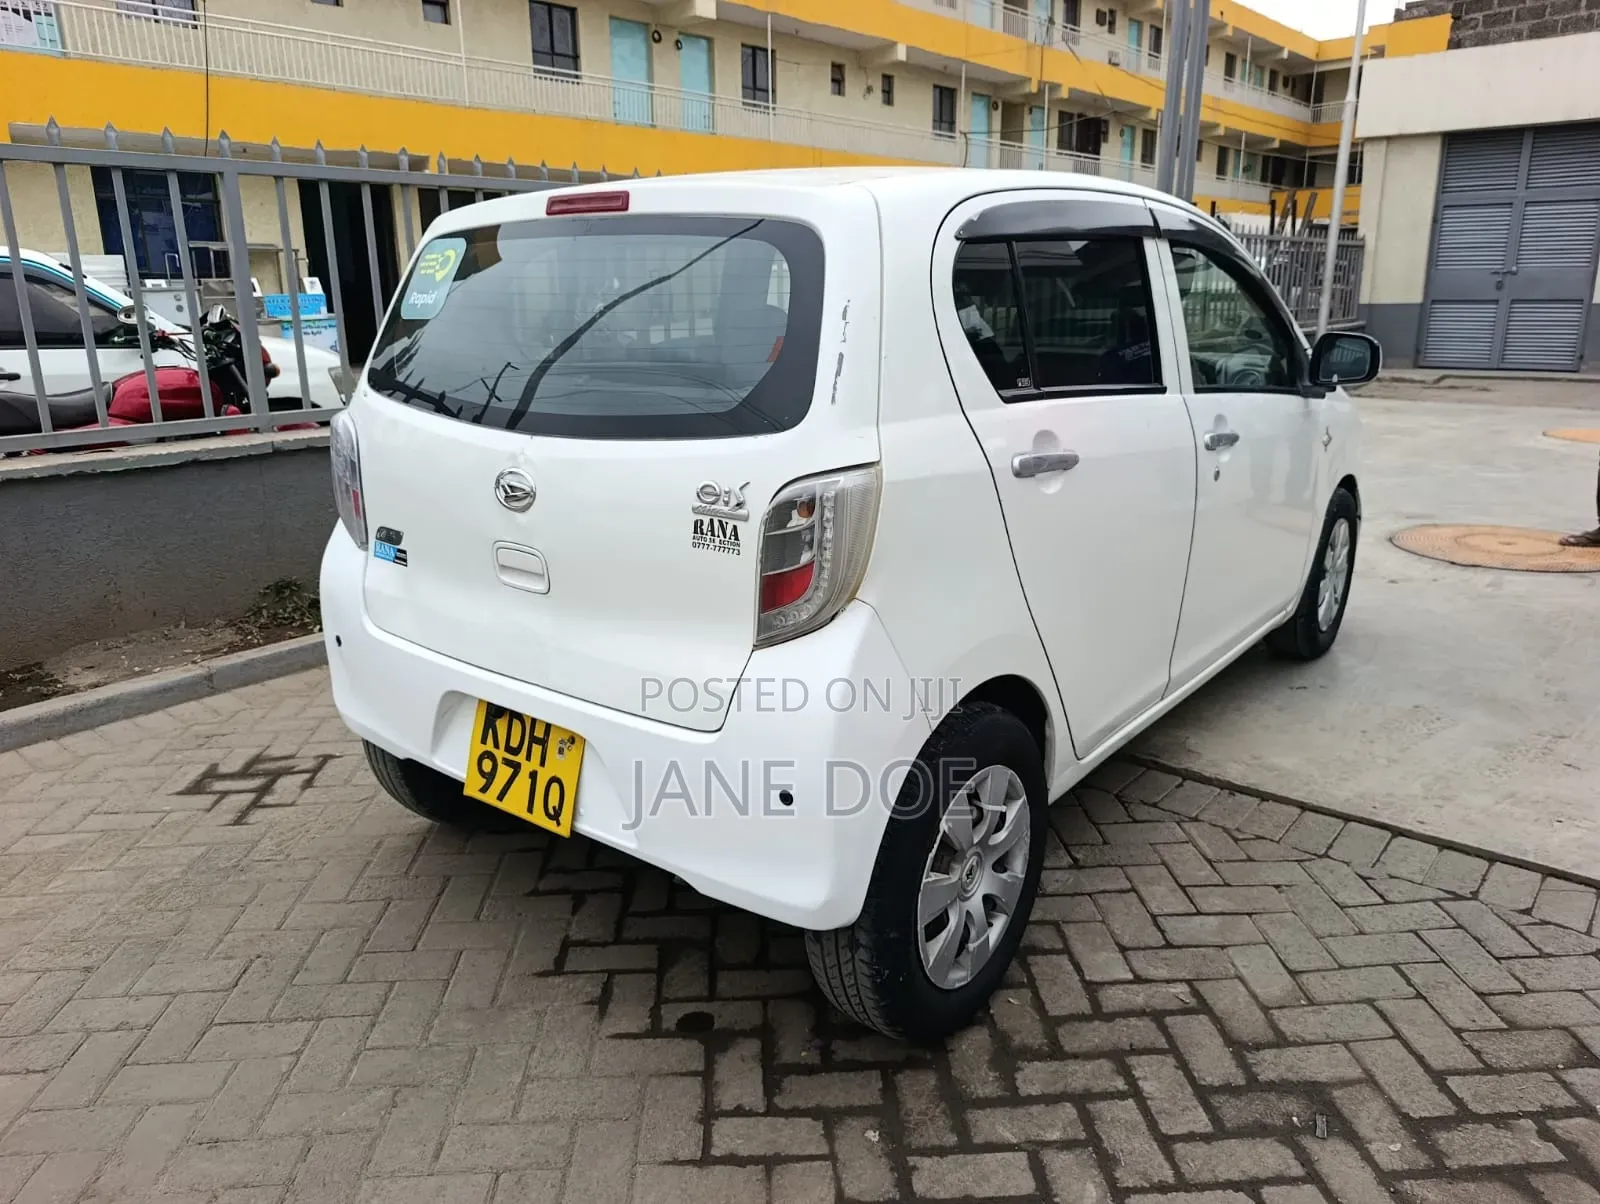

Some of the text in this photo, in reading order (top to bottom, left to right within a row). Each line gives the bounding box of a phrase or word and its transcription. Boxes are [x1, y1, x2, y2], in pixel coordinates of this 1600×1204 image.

[408, 290, 437, 308] Rapid
[693, 518, 740, 541] RANA
[692, 535, 741, 548] AUTO SEECTION
[480, 701, 552, 768] KDH
[477, 750, 565, 827] 971Q
